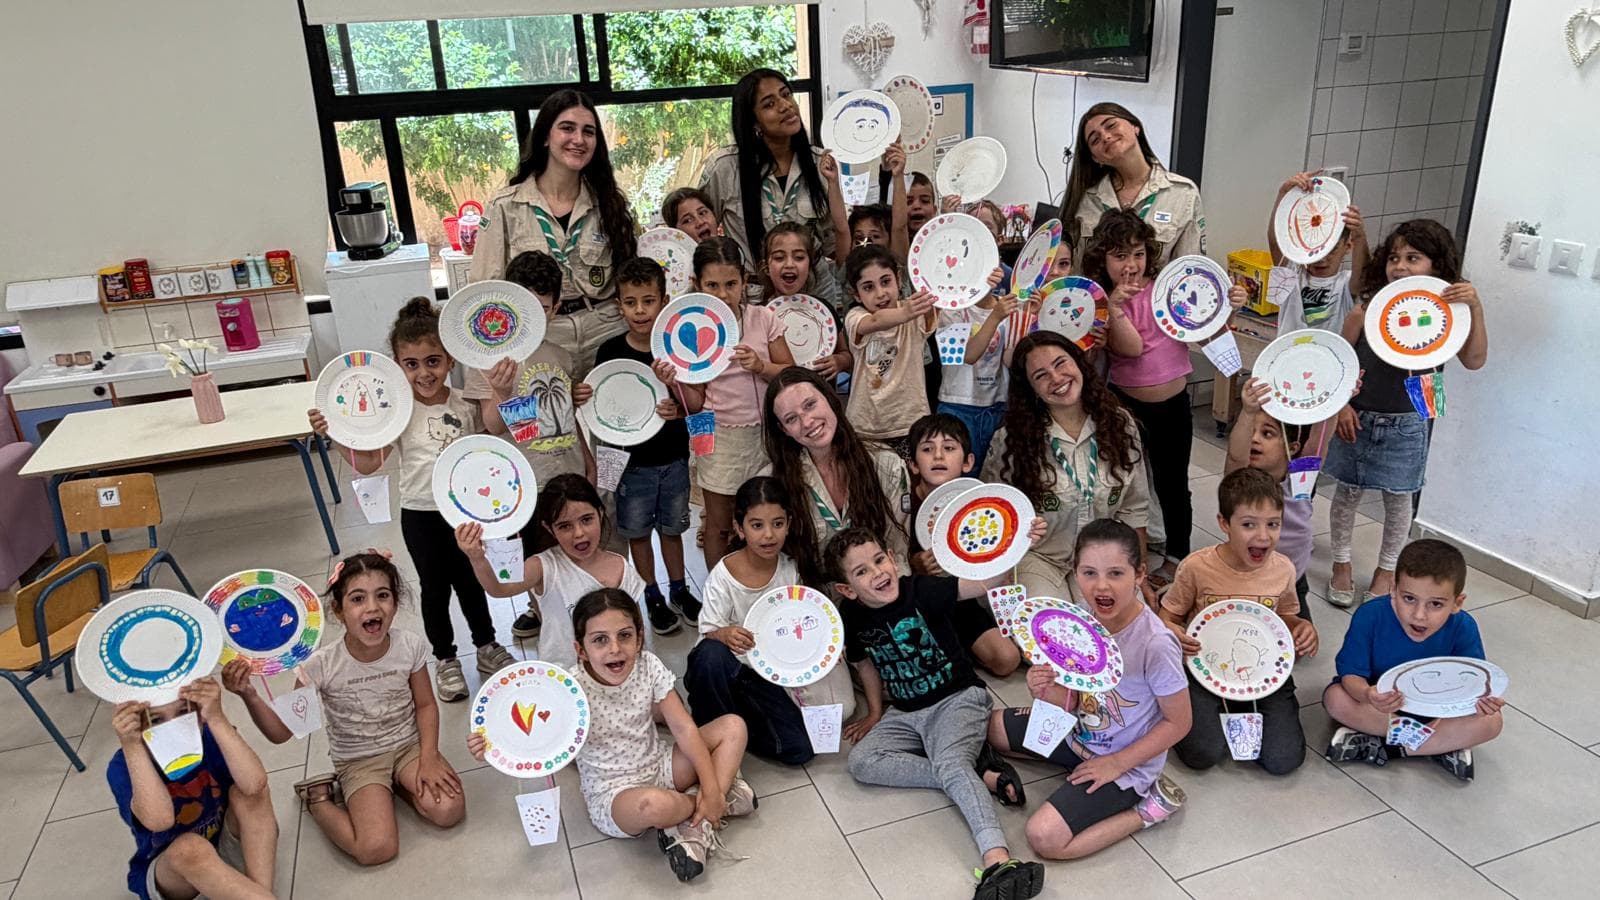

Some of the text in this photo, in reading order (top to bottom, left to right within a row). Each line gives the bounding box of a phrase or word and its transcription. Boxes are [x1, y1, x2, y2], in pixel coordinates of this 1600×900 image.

[1301, 286, 1331, 304] NIKE
[518, 363, 551, 396] SUMMER
[102, 490, 114, 501] 17
